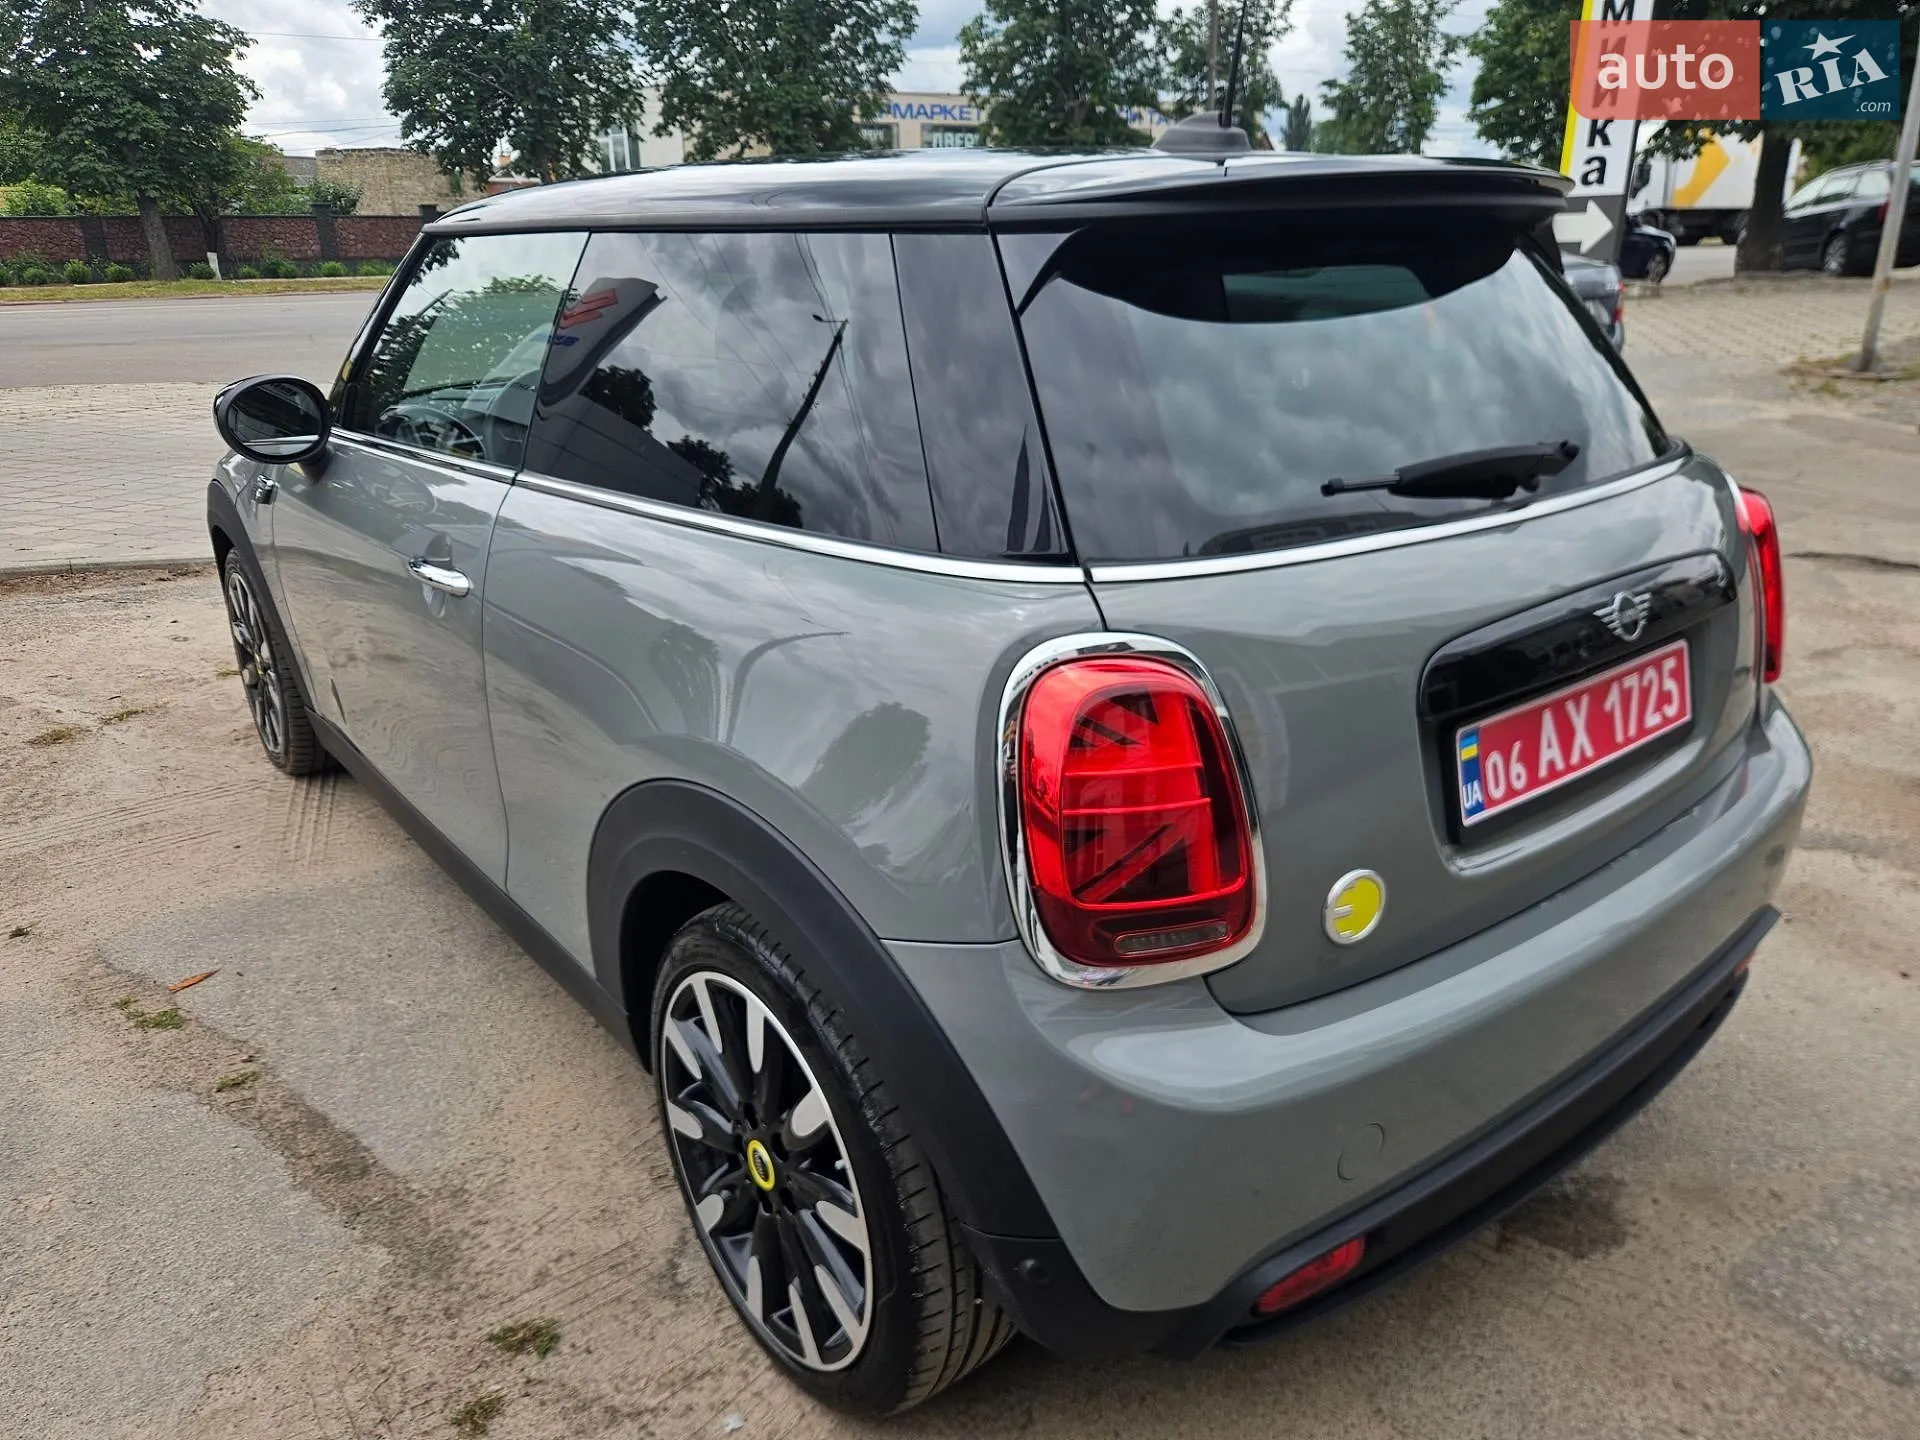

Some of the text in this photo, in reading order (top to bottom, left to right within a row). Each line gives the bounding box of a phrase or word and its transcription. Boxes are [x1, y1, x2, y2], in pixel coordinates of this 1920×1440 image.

[1485, 657, 1680, 800] 06 AX 1725
[1462, 780, 1483, 809] UA
